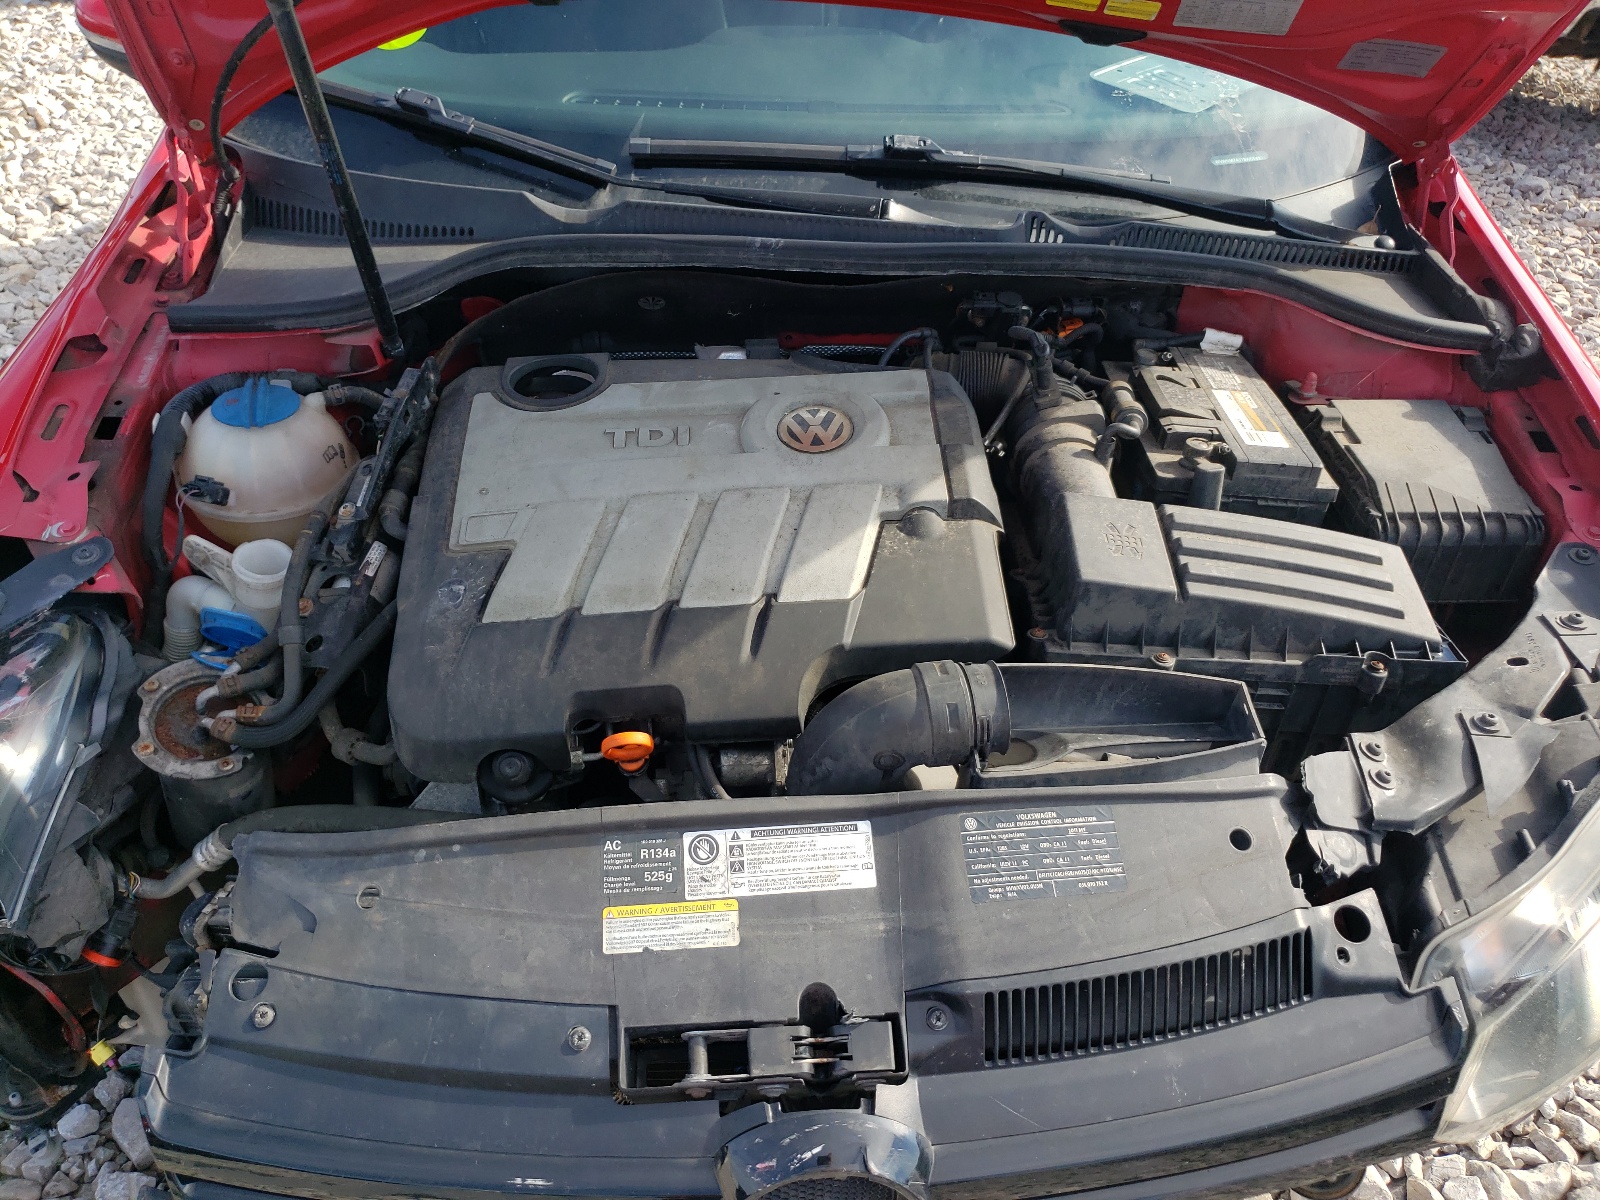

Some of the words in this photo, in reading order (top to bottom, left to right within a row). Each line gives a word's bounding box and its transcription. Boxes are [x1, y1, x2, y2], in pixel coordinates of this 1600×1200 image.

[604, 425, 691, 449] TDI
[1016, 811, 1057, 820] VOLKSWAGEN
[604, 840, 622, 851] AC
[640, 847, 676, 860] R134a
[644, 870, 673, 883] 525g
[616, 906, 653, 916] WARNING
[660, 903, 717, 914] AVERTISSEMENT
